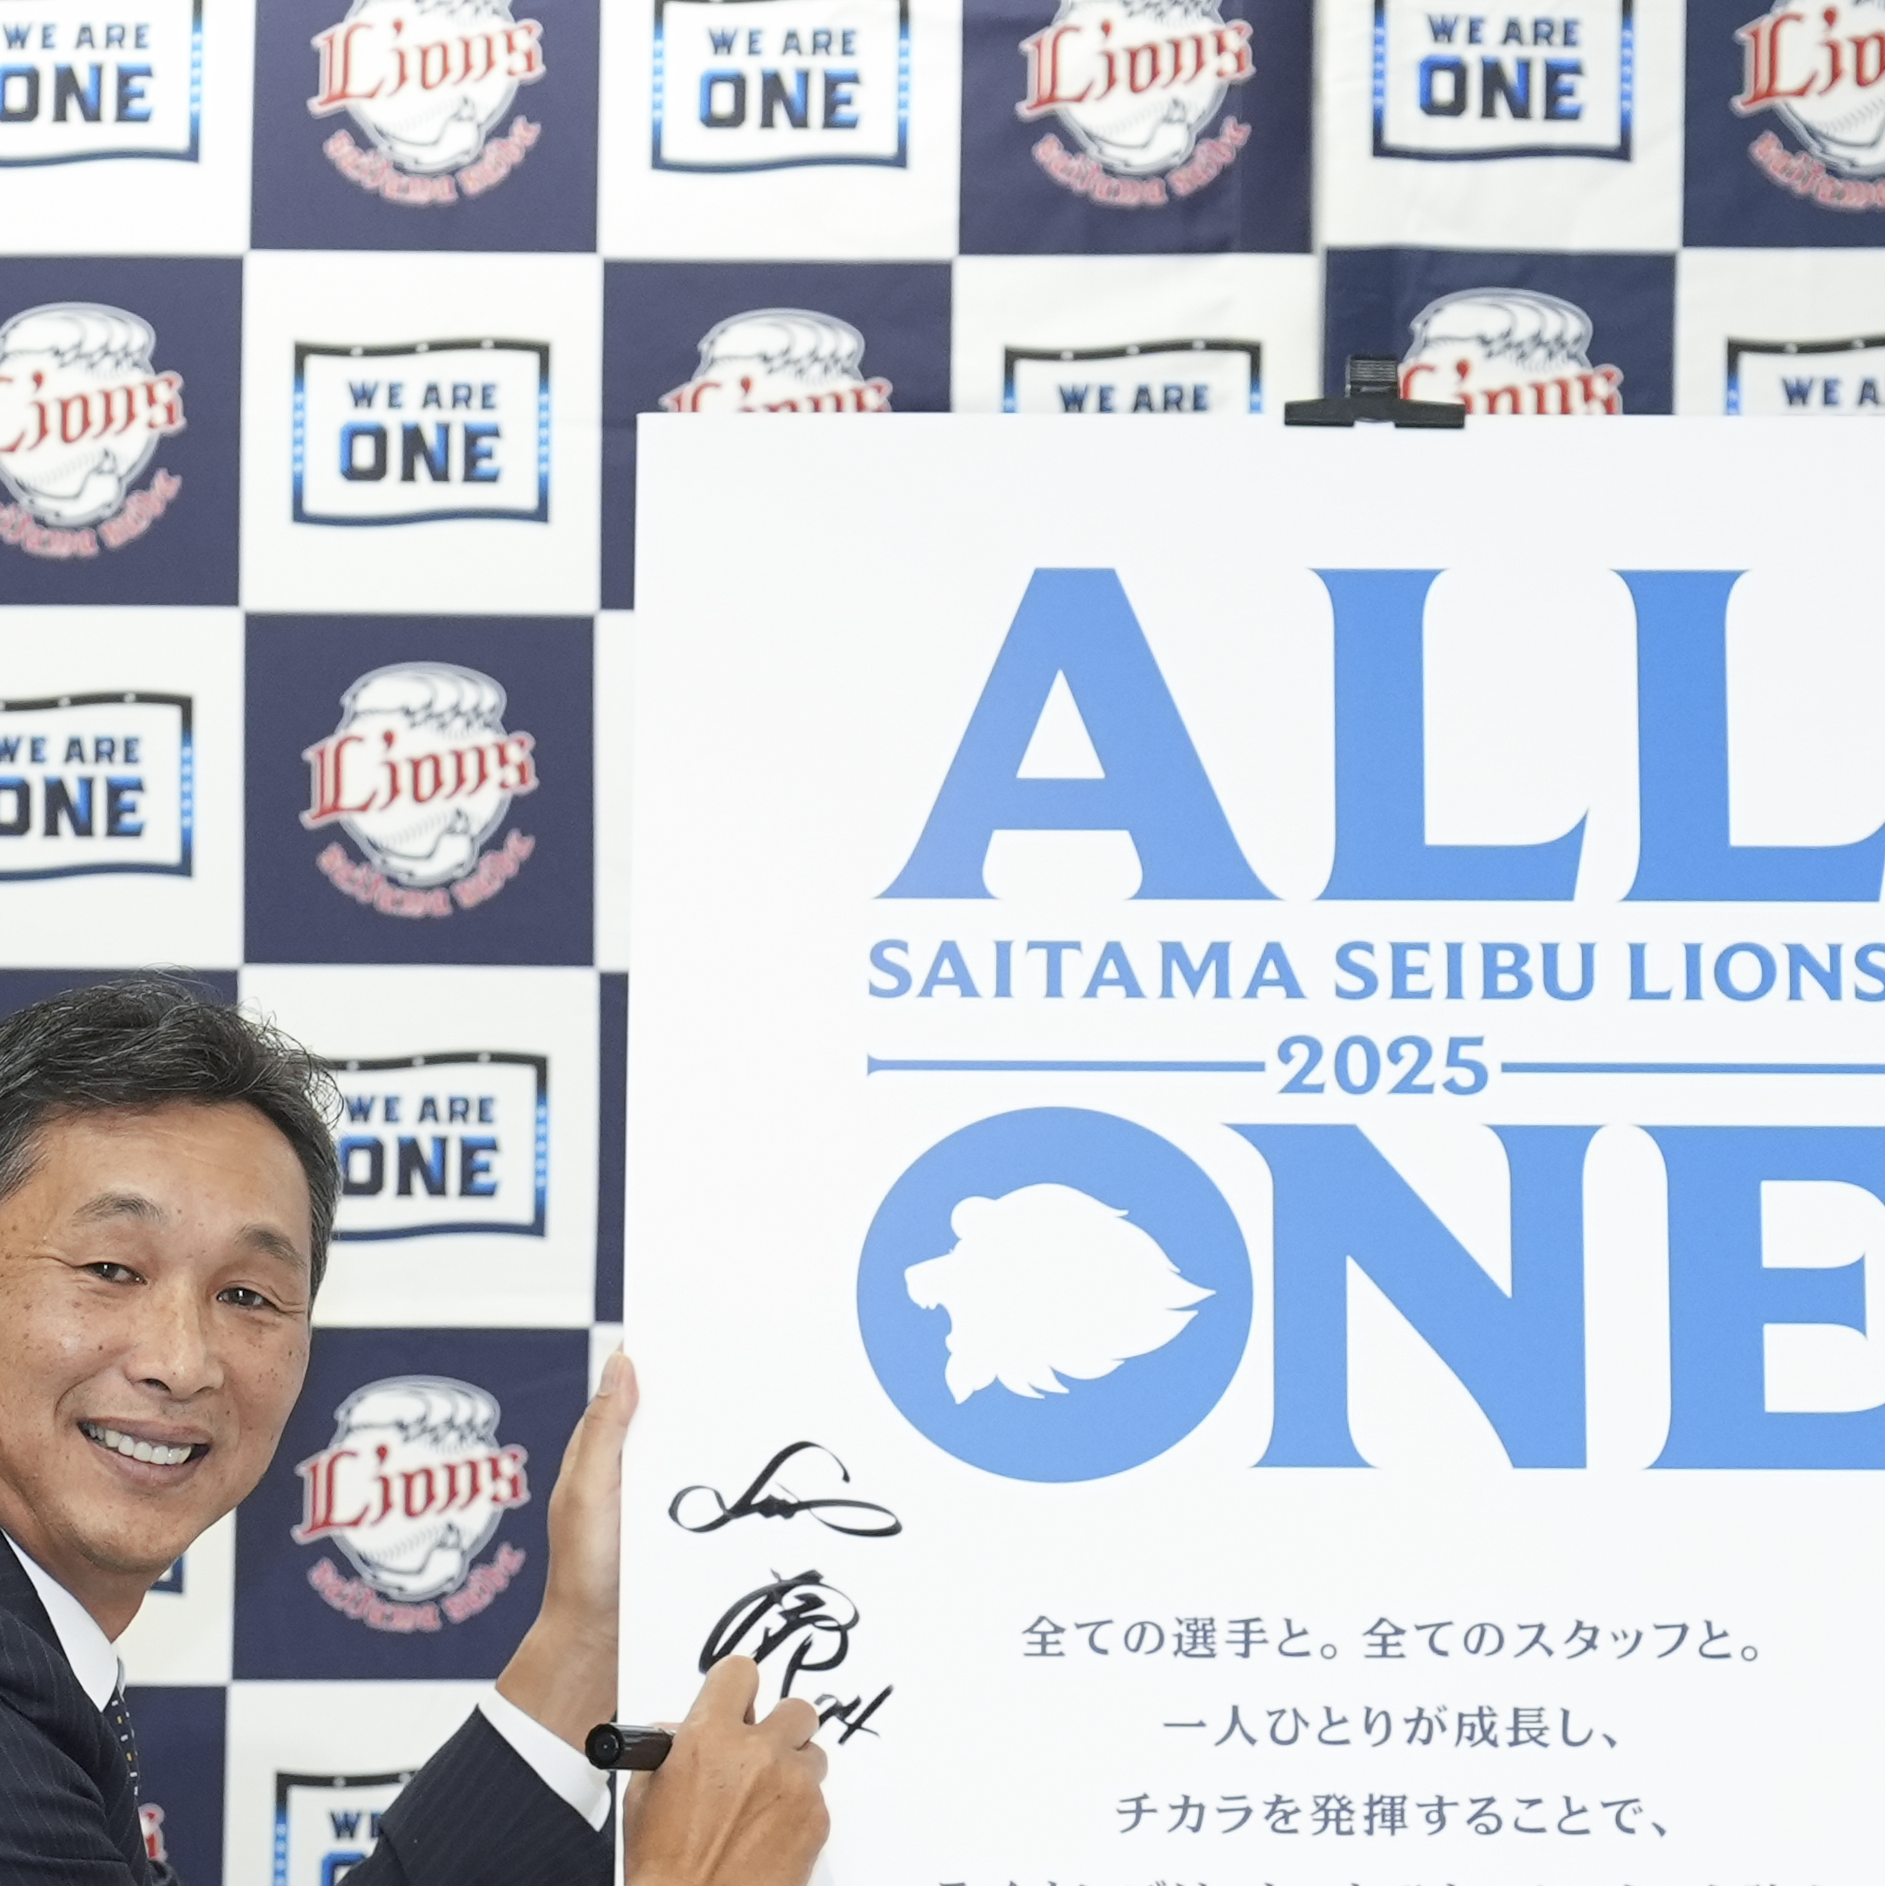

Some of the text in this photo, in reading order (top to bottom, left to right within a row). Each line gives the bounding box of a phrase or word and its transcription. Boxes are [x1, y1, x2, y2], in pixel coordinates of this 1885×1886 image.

[709, 28, 856, 57] WE ARE
[1428, 15, 1579, 48] WE ARE
[316, 20, 539, 107] Lions
[1026, 20, 1251, 112] Lions
[1419, 55, 1583, 121] ONE
[699, 69, 861, 130] ONE
[349, 382, 496, 410] WE ARE
[340, 422, 501, 483] ONE
[64, 737, 139, 765] ARE
[309, 730, 533, 821] Lions
[869, 939, 1307, 999] SAITAMA
[1335, 941, 1596, 1001] SEIBU
[1277, 1035, 1489, 1096] 2025
[300, 1444, 526, 1538] Lions
[1022, 1616, 1758, 1662] 全ての選手と。全てのスタッフと。
[1163, 1705, 1617, 1748] 一人ひとりが成長し、
[1117, 1793, 1666, 1837] チカラを発揮することで、
